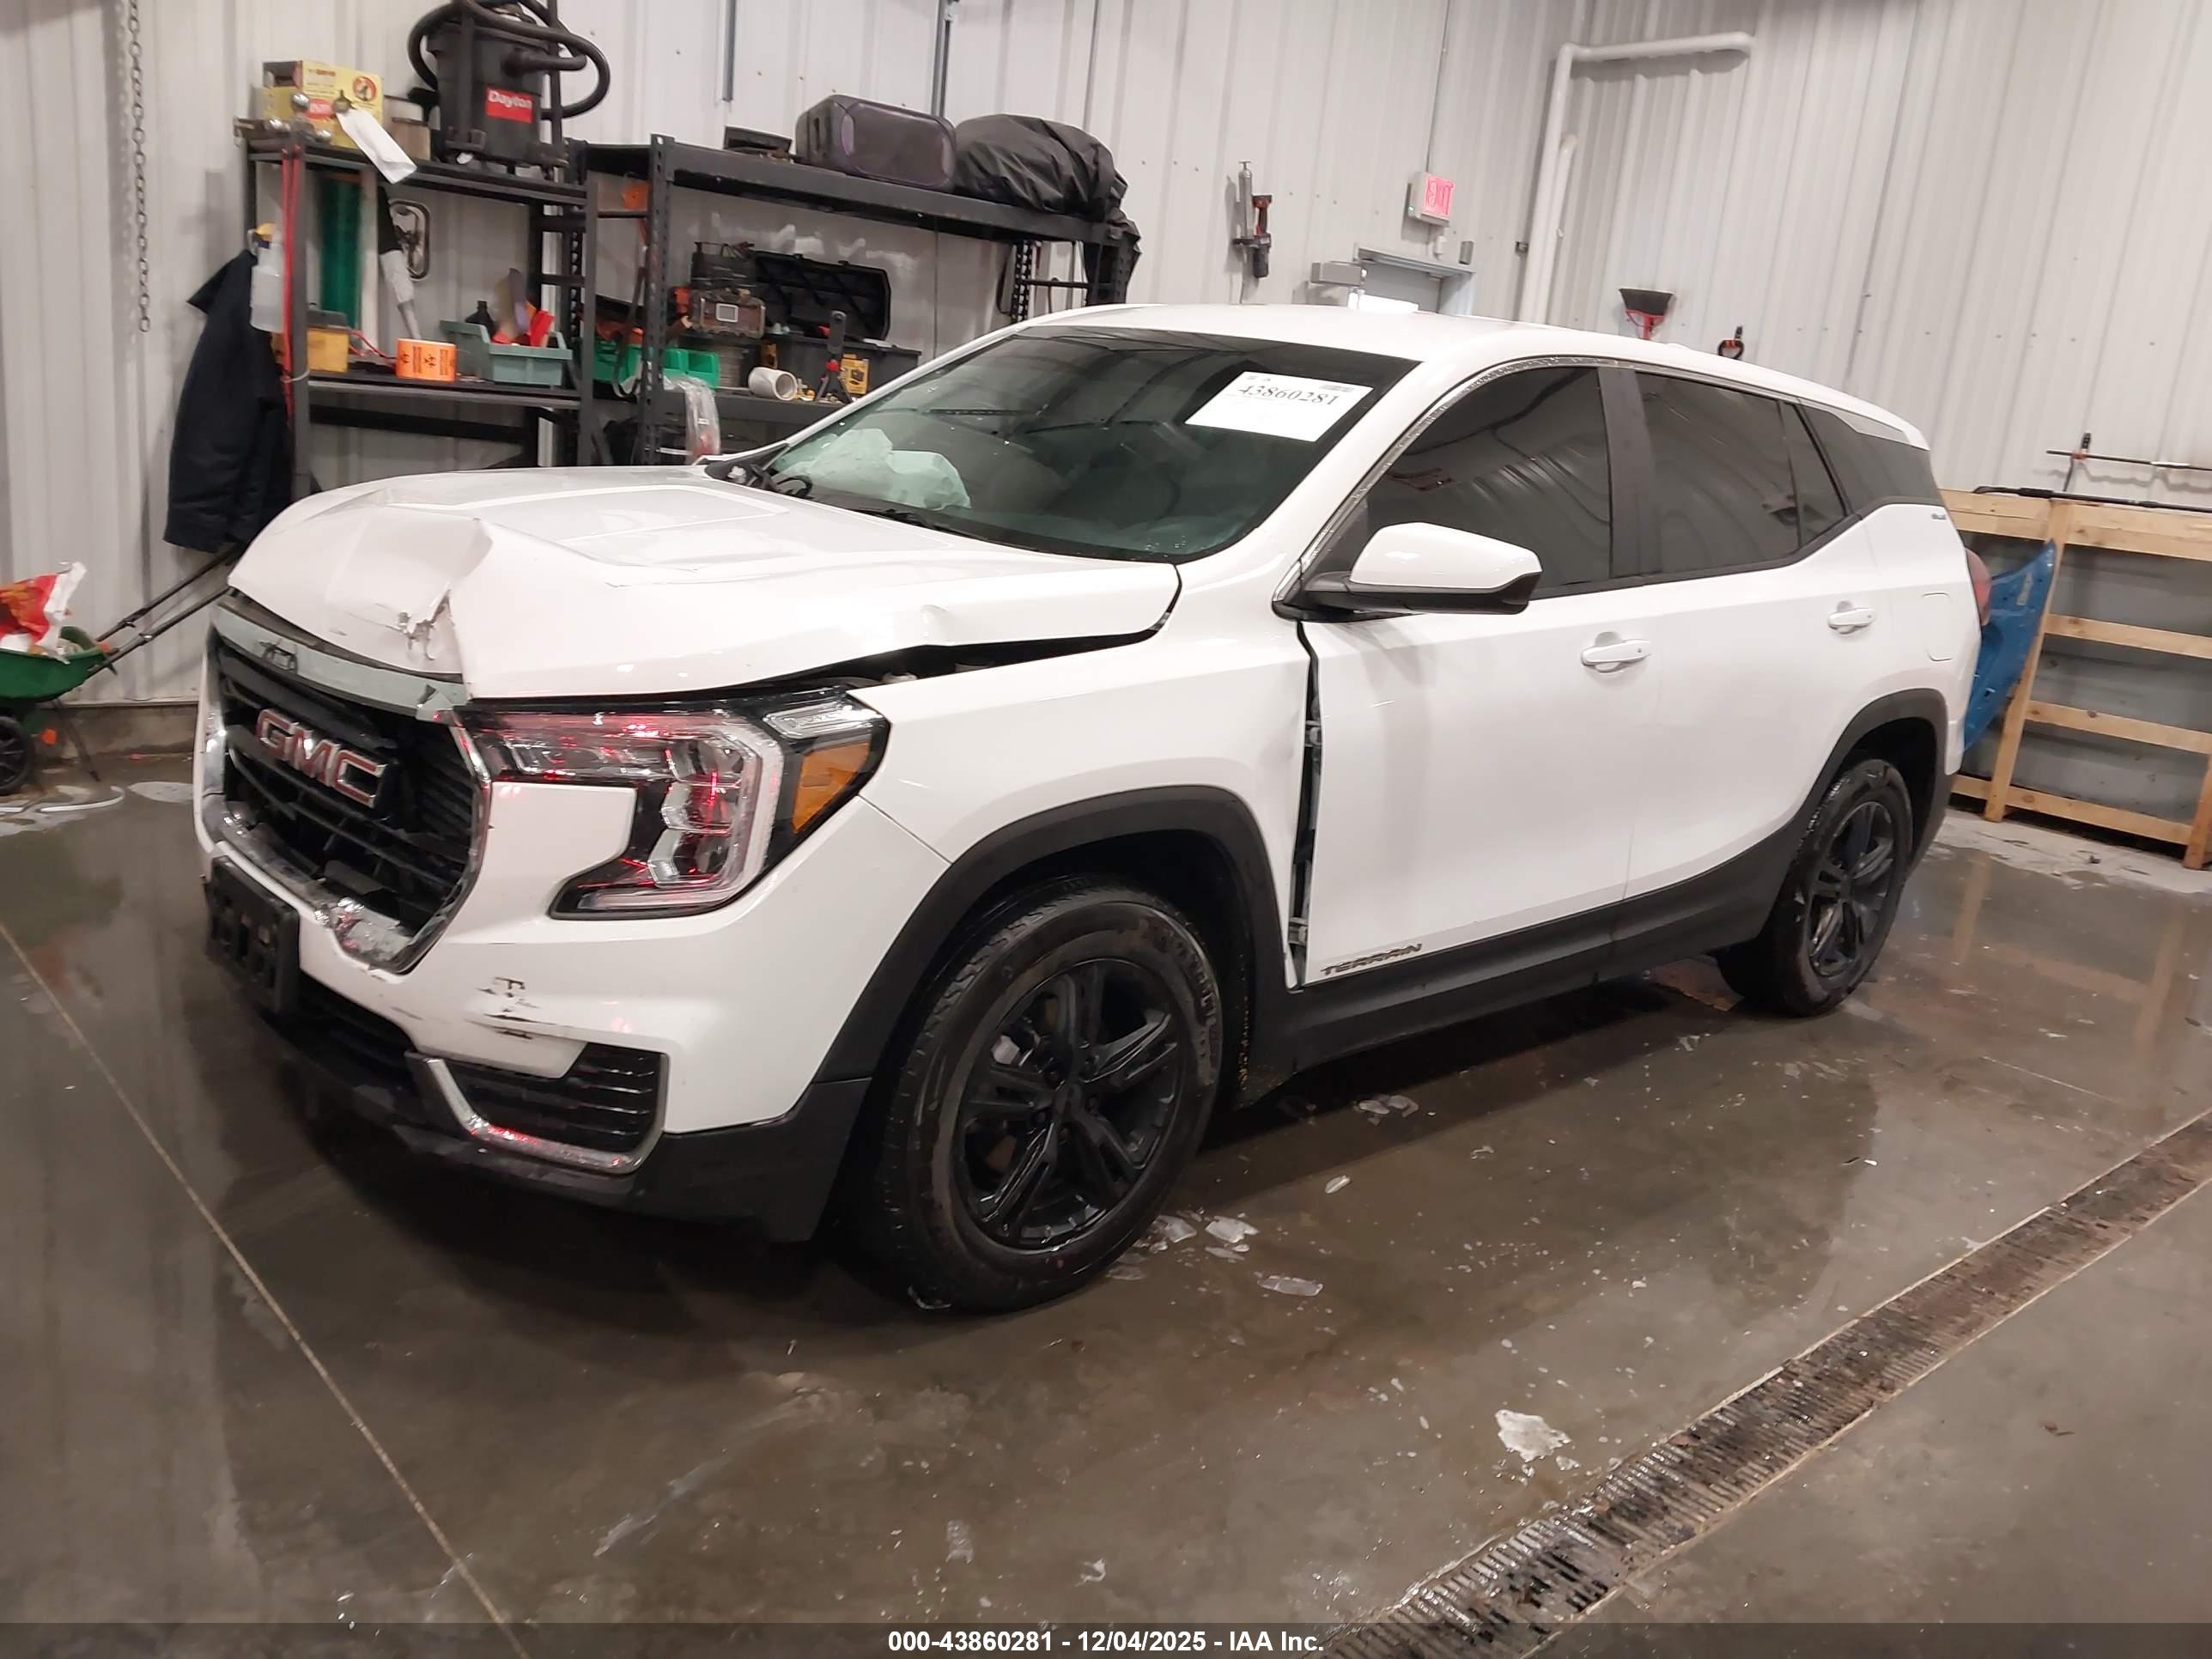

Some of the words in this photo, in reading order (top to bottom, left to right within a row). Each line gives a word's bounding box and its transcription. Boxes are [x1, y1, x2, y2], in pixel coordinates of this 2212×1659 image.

[487, 88, 532, 109] Dayton
[1238, 385, 1340, 405] 43860281
[257, 708, 388, 809] GMC
[1320, 943, 1423, 976] TERRAIN
